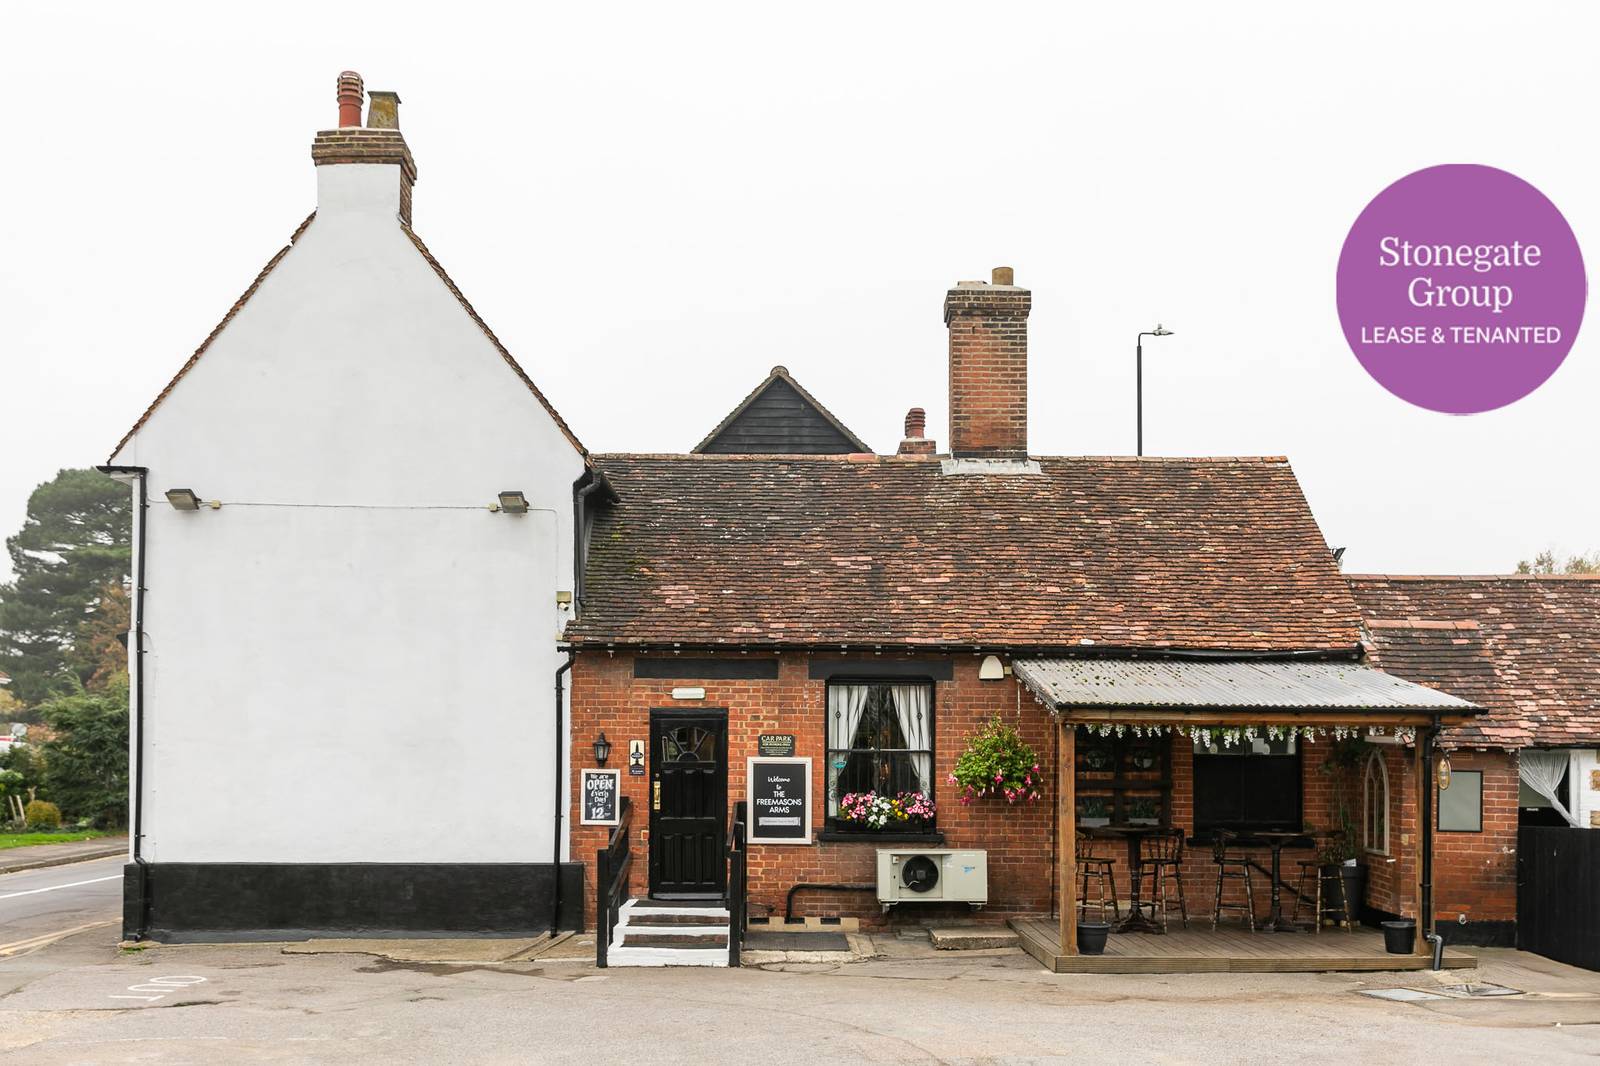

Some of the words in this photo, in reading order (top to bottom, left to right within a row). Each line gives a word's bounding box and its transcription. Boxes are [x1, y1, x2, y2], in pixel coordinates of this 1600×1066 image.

[587, 779, 614, 790] OPEN
[756, 798, 802, 806] FREEMASONS
[591, 807, 605, 820] 12
